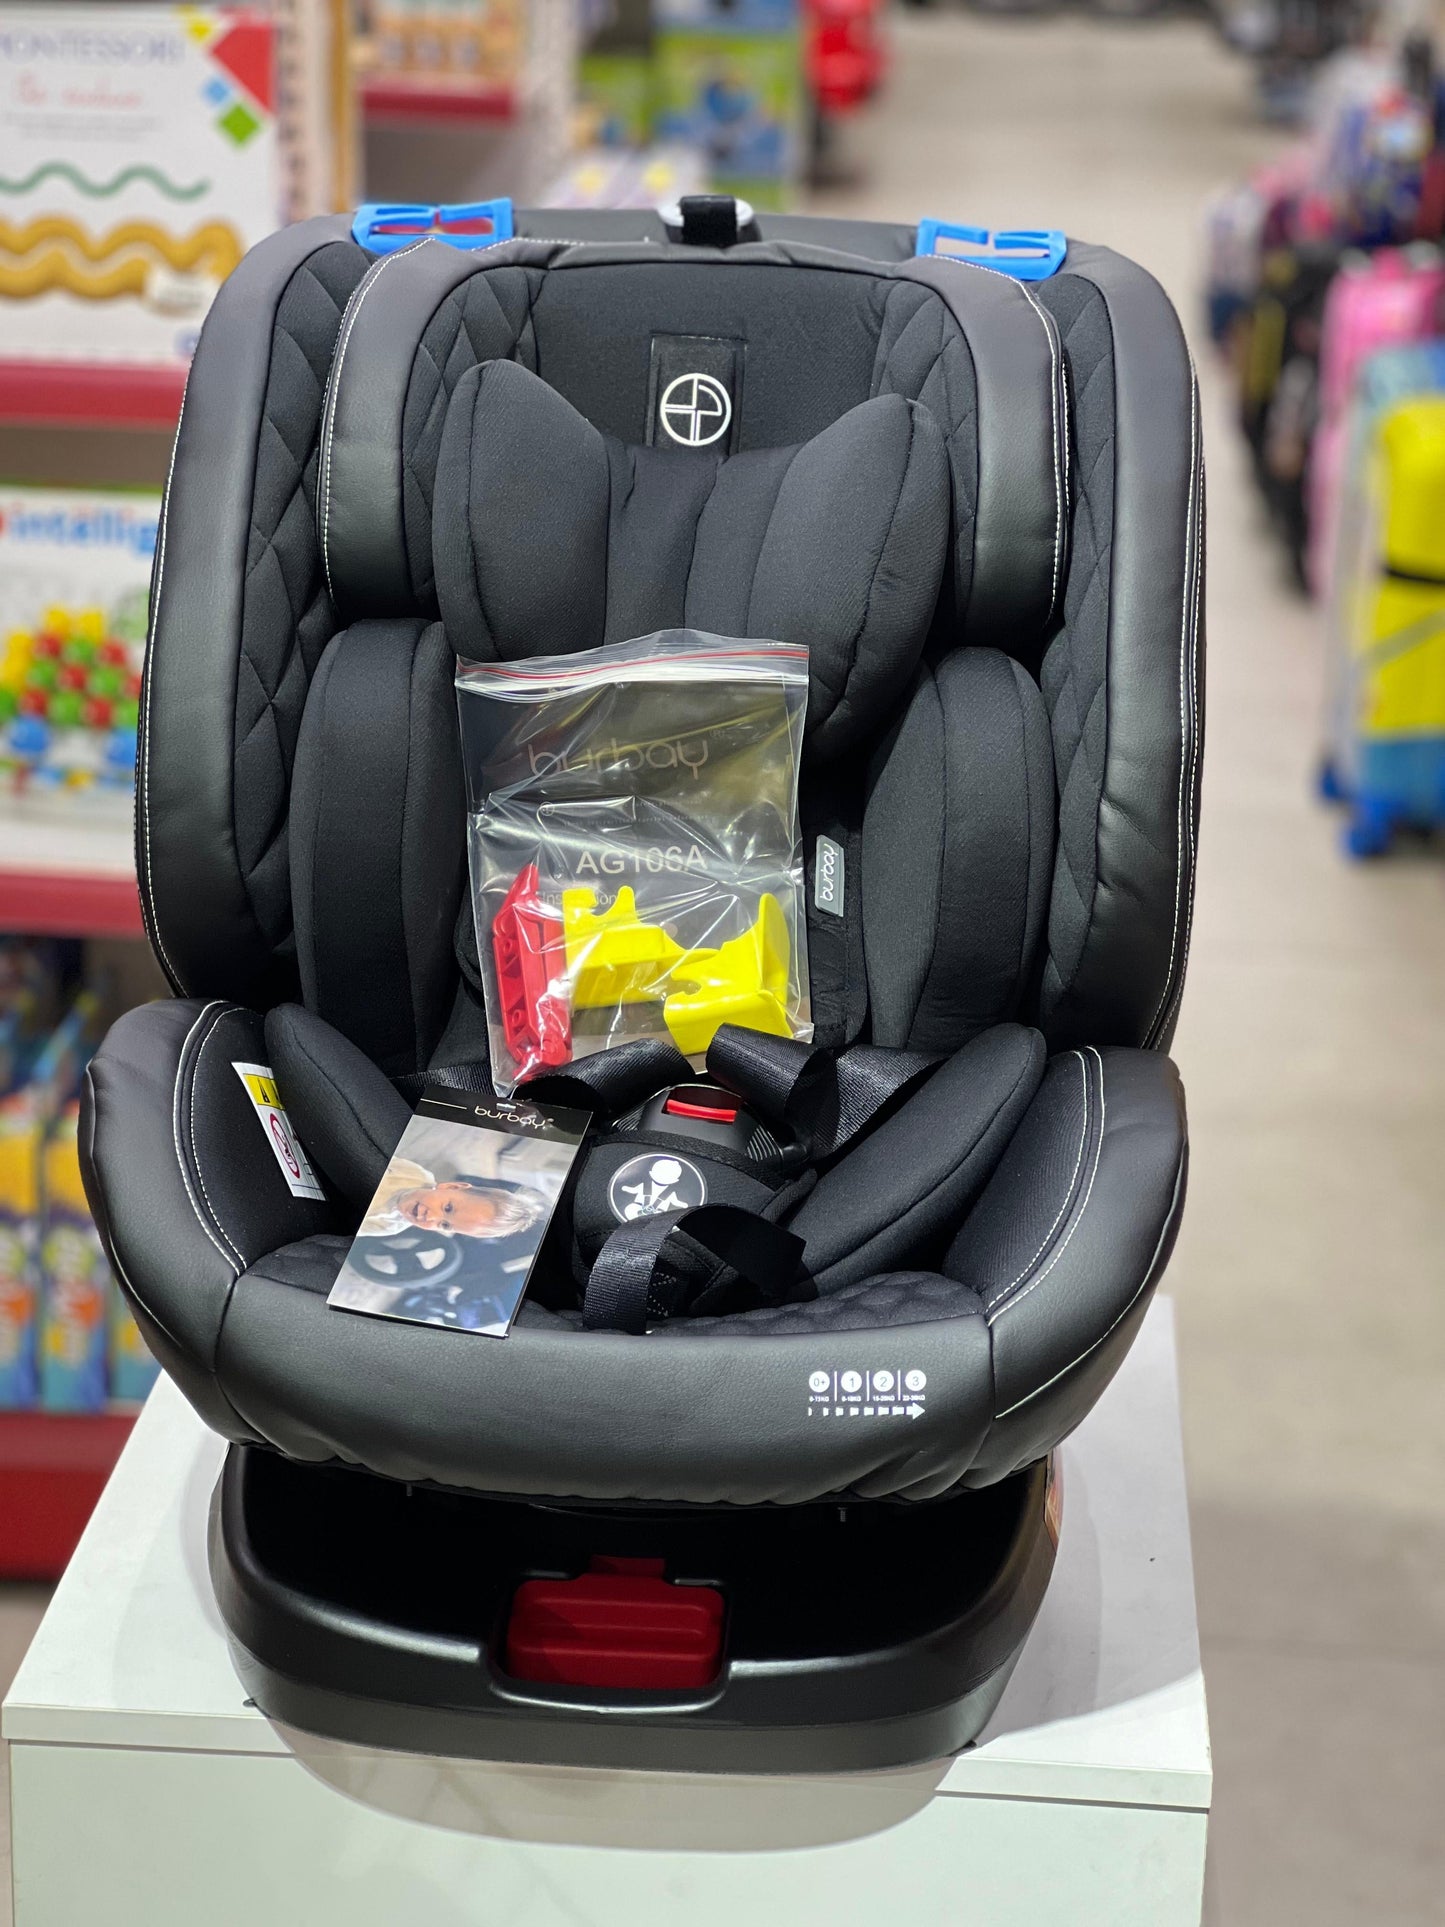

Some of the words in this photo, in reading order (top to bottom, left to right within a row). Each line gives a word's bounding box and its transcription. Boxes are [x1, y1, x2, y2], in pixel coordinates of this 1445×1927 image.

[527, 737, 708, 780] burbay
[576, 844, 708, 875] AG106A
[820, 843, 838, 902] burbay
[474, 1105, 546, 1130] burbay
